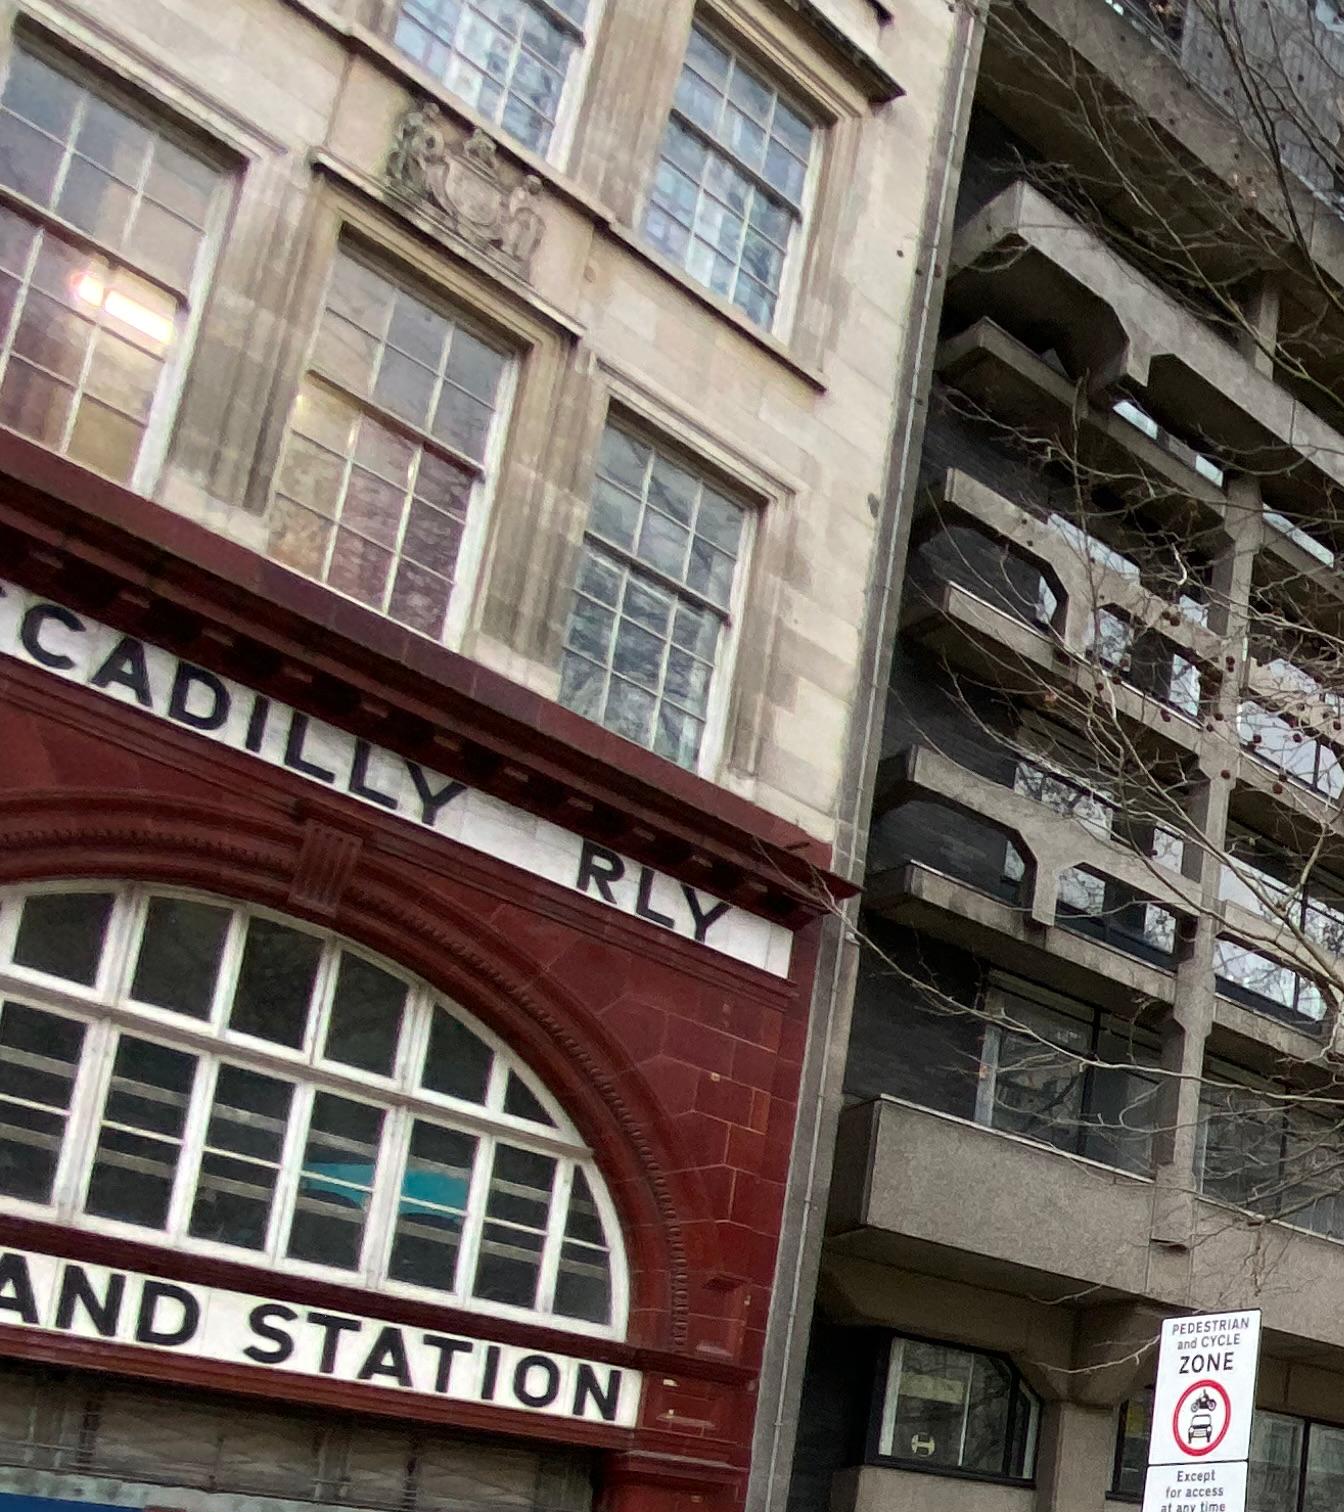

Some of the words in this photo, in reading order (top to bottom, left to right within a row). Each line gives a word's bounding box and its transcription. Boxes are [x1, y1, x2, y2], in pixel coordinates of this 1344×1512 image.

[0, 585, 467, 826] CADILLY
[577, 838, 732, 943] RLY
[1172, 1317, 1250, 1335] PEDESTRIAN
[1177, 1337, 1198, 1350] and
[1201, 1333, 1240, 1348] CYCLE
[243, 1303, 622, 1421] STATION
[1179, 1352, 1234, 1374] ZONE
[1177, 1469, 1216, 1483] Except
[1166, 1486, 1182, 1498] for
[1185, 1487, 1224, 1497] access
[1200, 1501, 1226, 1512] time
